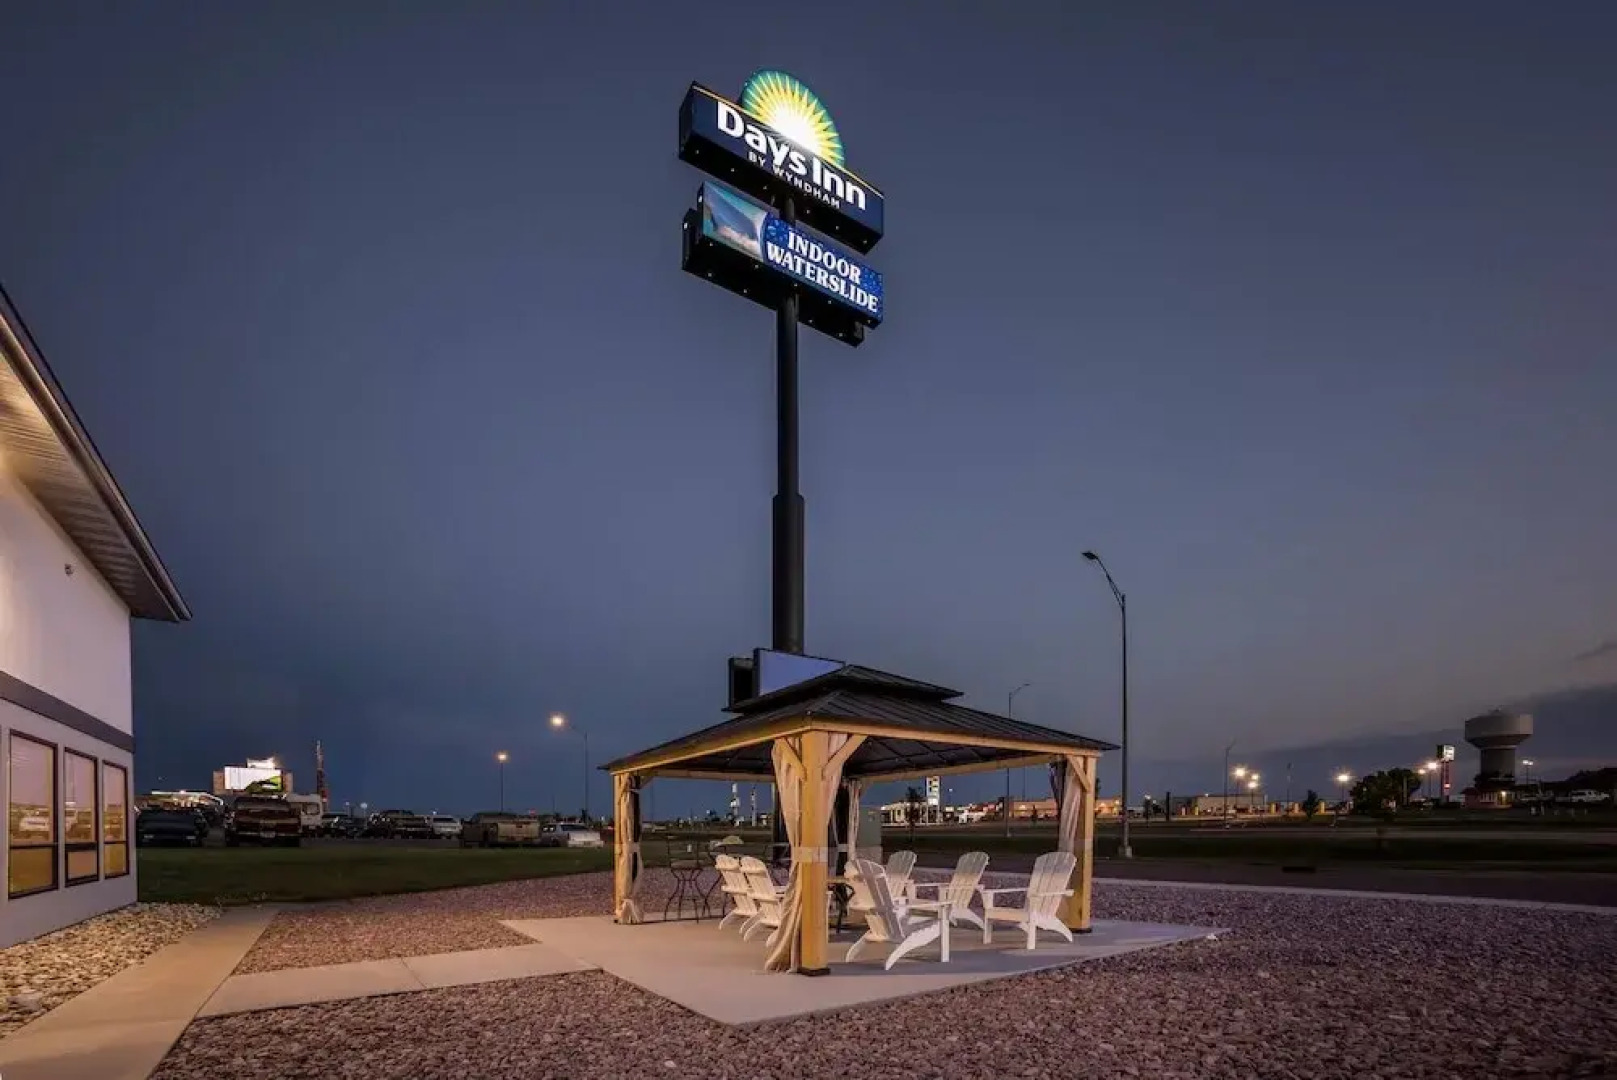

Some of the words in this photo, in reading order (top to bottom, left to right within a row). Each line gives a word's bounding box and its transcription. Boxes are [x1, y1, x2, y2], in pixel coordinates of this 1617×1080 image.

[717, 101, 806, 174] Days
[813, 155, 866, 210] Inn
[748, 151, 766, 168] BY
[773, 164, 840, 210] WYNDHAM
[766, 243, 878, 312] WATERSLIDE
[788, 230, 861, 284] INDOOR
